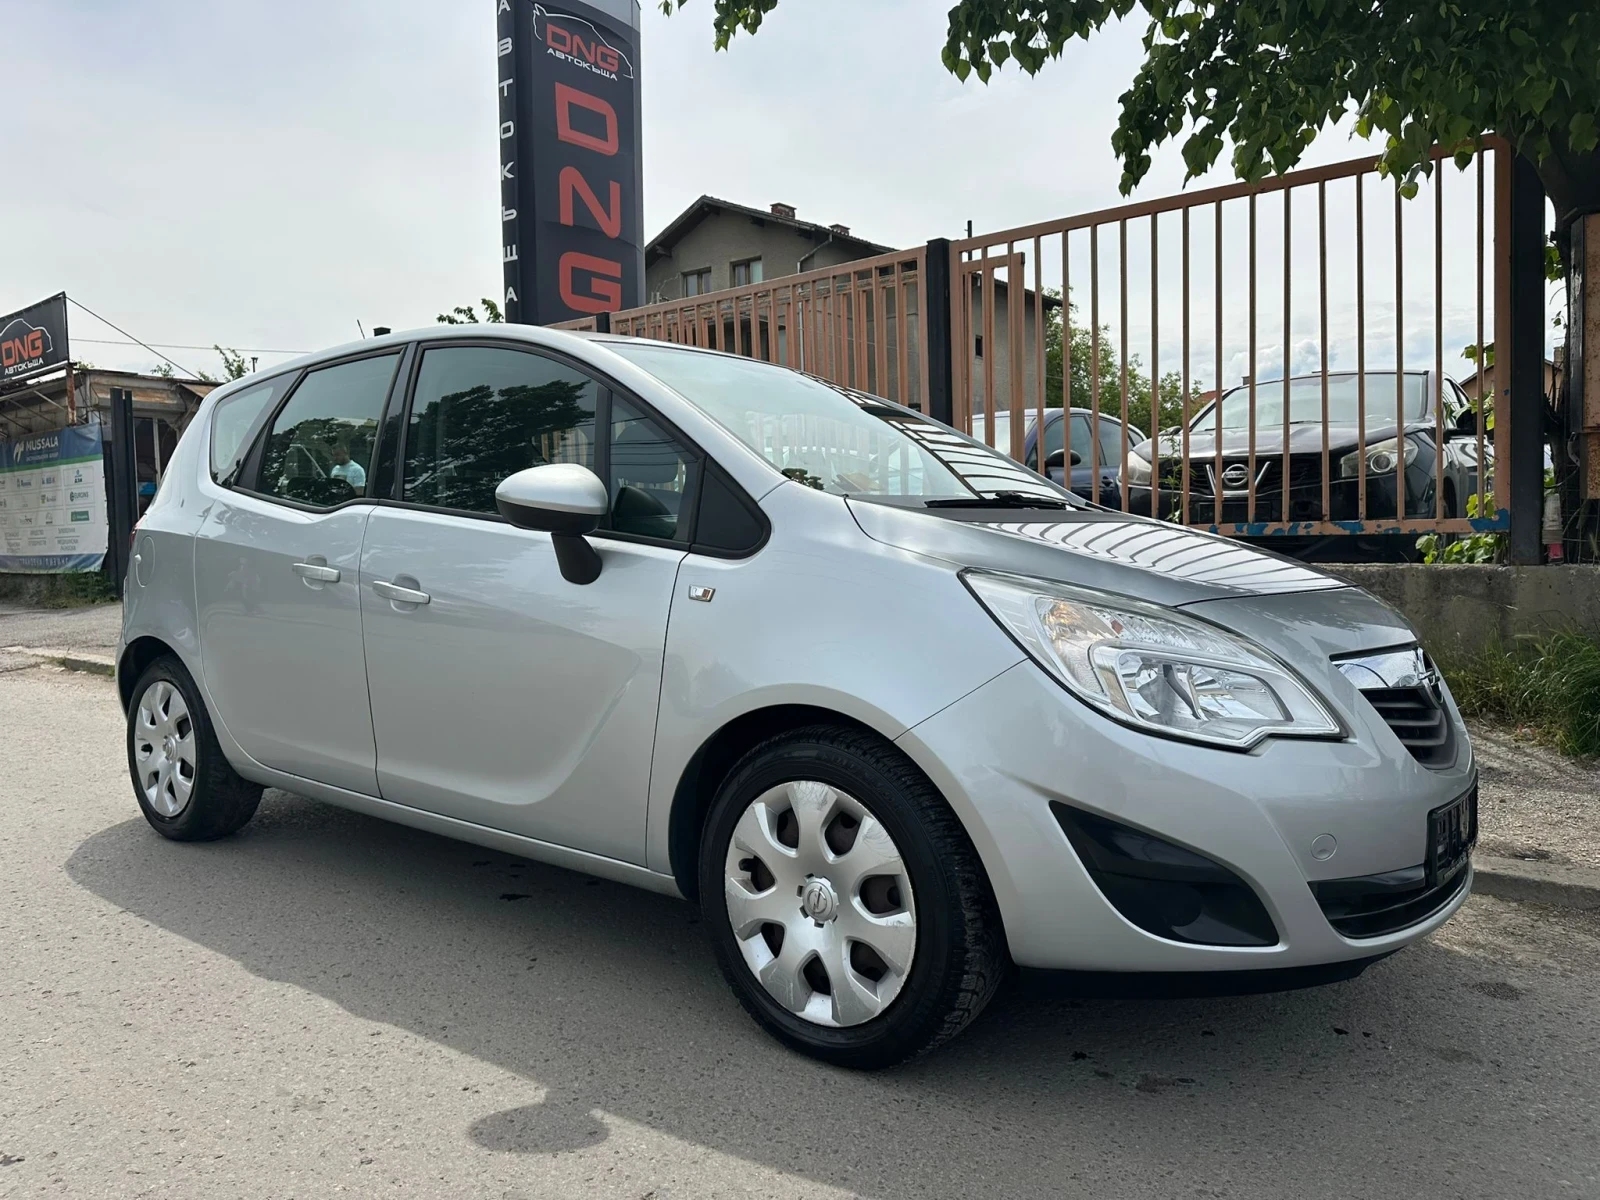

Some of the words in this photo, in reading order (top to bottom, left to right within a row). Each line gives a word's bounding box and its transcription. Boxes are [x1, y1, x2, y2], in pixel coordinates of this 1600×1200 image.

[547, 23, 619, 72] DNG
[555, 82, 621, 314] DNG
[1, 330, 43, 367] DNG
[25, 435, 59, 452] MUSSALA
